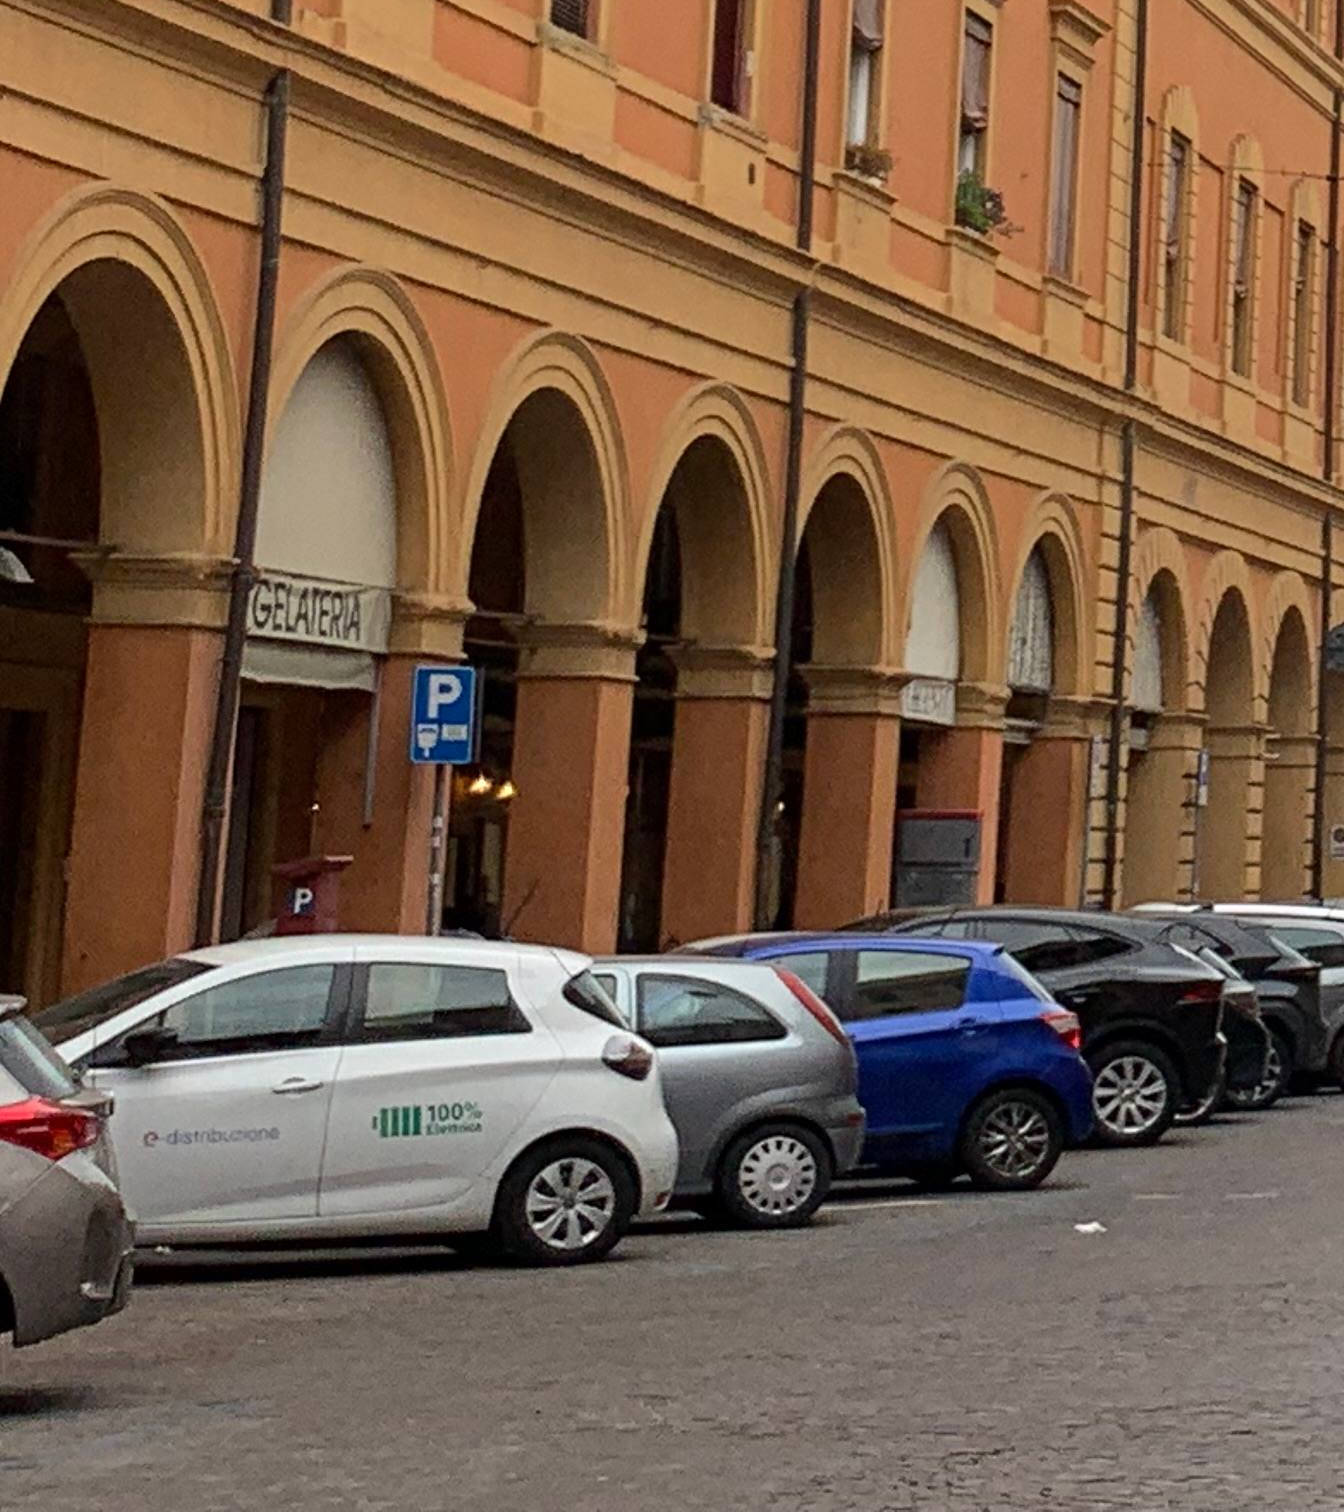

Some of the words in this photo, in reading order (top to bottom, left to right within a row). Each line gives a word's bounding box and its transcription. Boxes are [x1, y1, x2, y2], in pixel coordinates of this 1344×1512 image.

[252, 579, 361, 641] GELATERIA
[427, 673, 463, 719] P
[293, 887, 314, 914] P
[427, 1101, 483, 1122] 100%
[426, 1122, 482, 1136] Eleca
